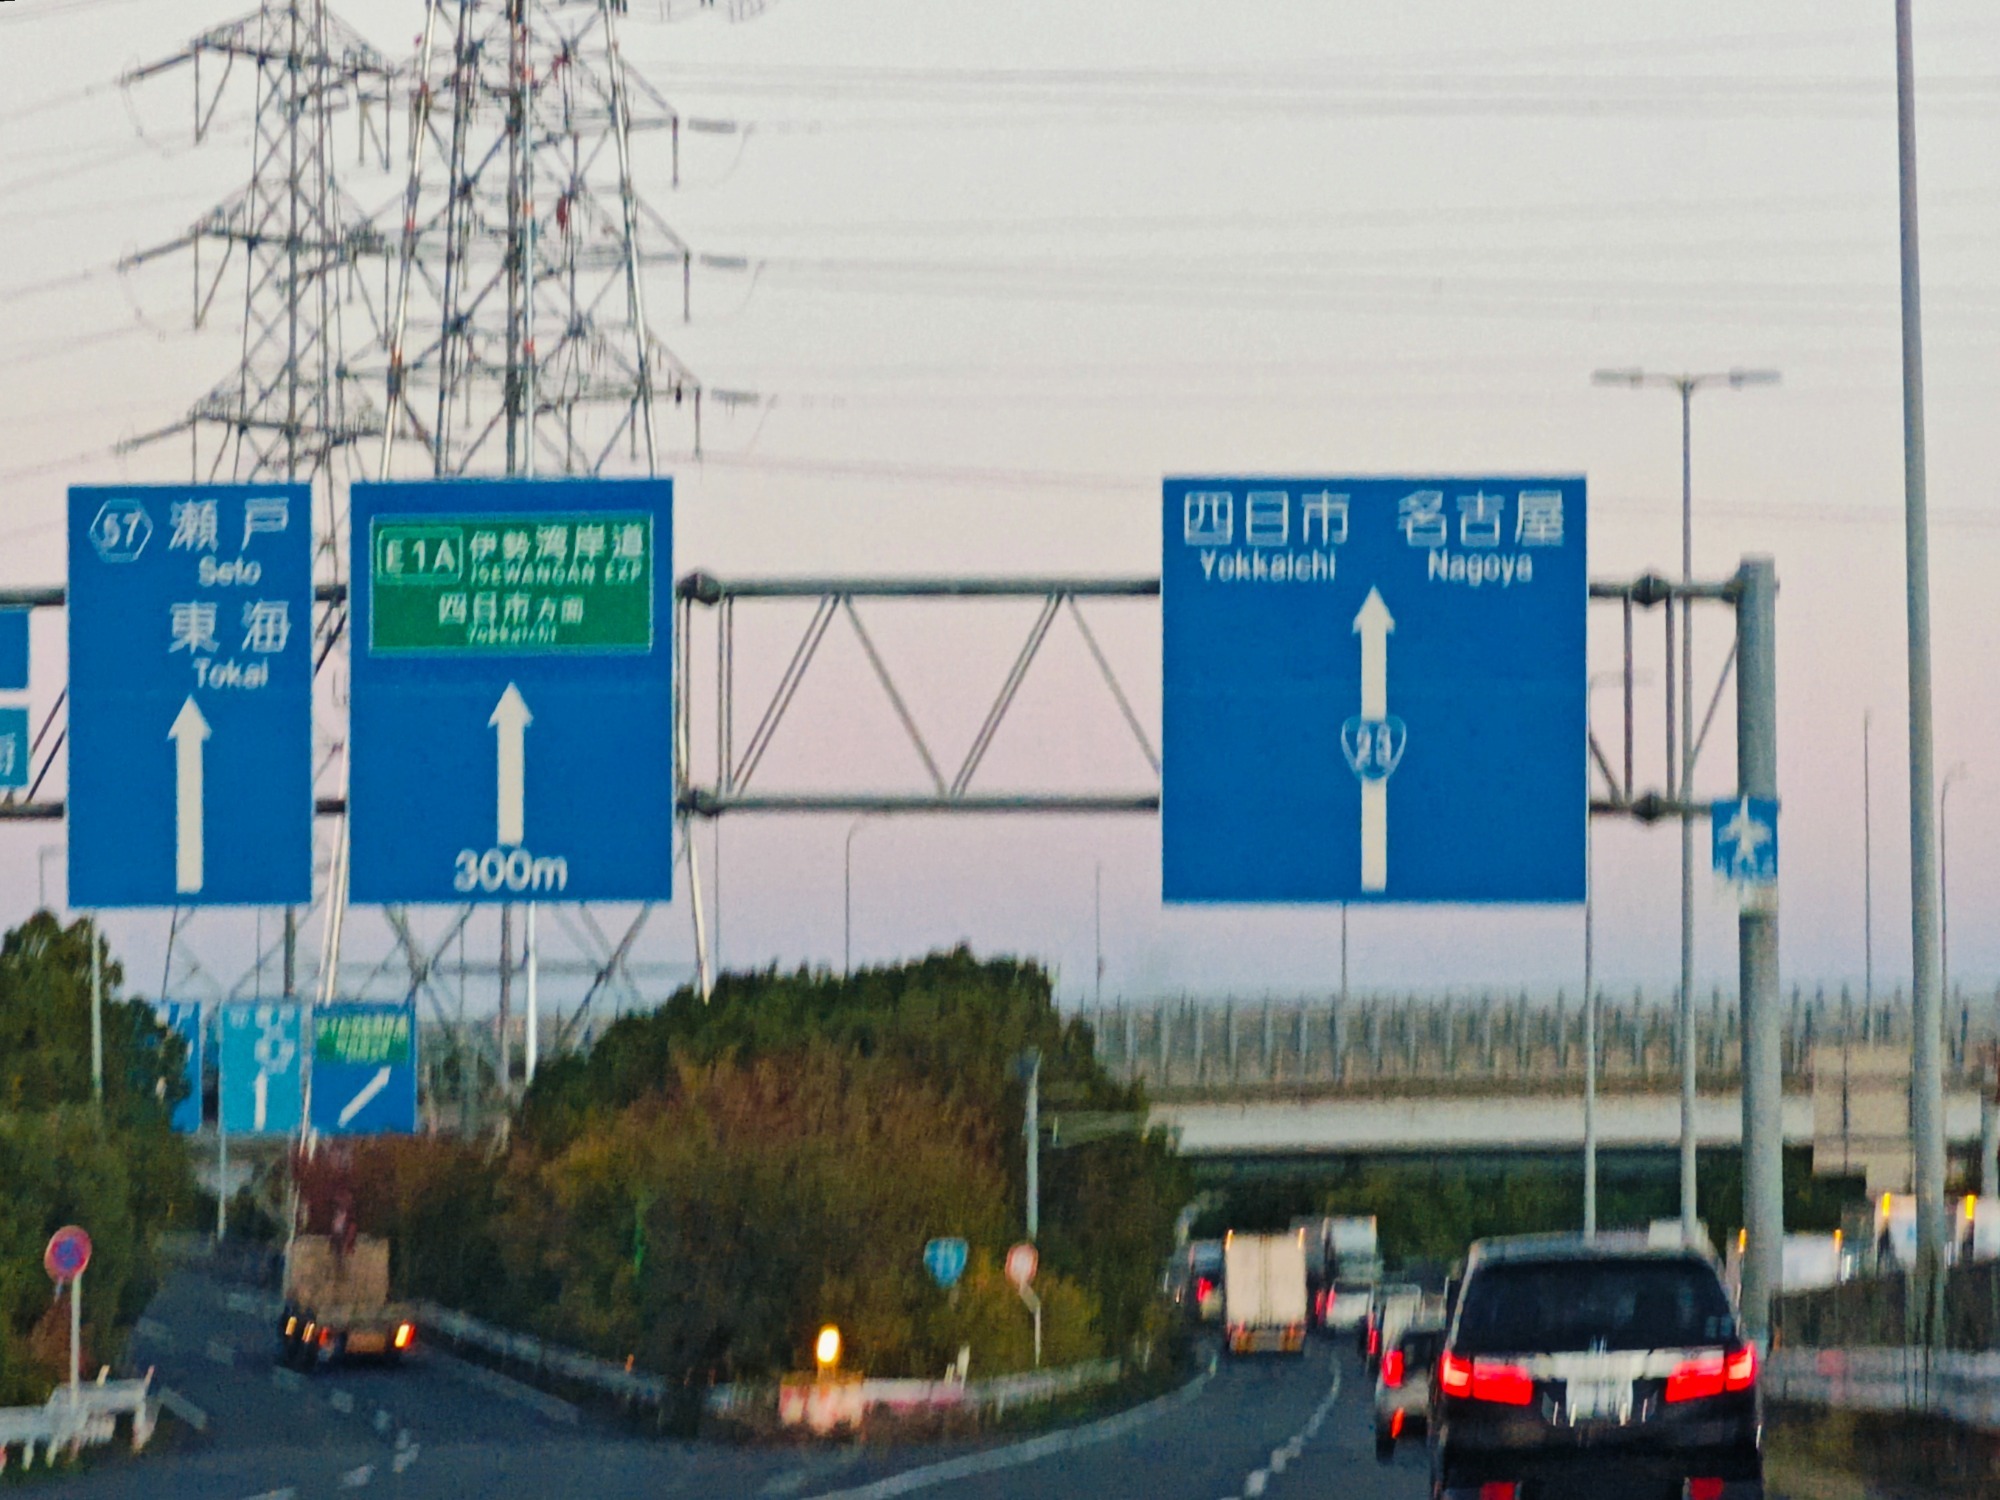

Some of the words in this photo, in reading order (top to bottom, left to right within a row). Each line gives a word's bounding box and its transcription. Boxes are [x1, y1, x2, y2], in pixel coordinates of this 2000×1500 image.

[168, 498, 290, 552] 瀬戸
[1183, 489, 1351, 547] 四日市
[1397, 489, 1564, 547] 名古屋
[198, 554, 262, 588] Seto
[386, 539, 456, 574] E1A
[1199, 548, 1336, 583] Yokkaichi
[1428, 548, 1533, 587] Nagoya
[168, 598, 291, 655] 東海
[193, 657, 269, 690] Tokai
[453, 847, 569, 893] 300m
